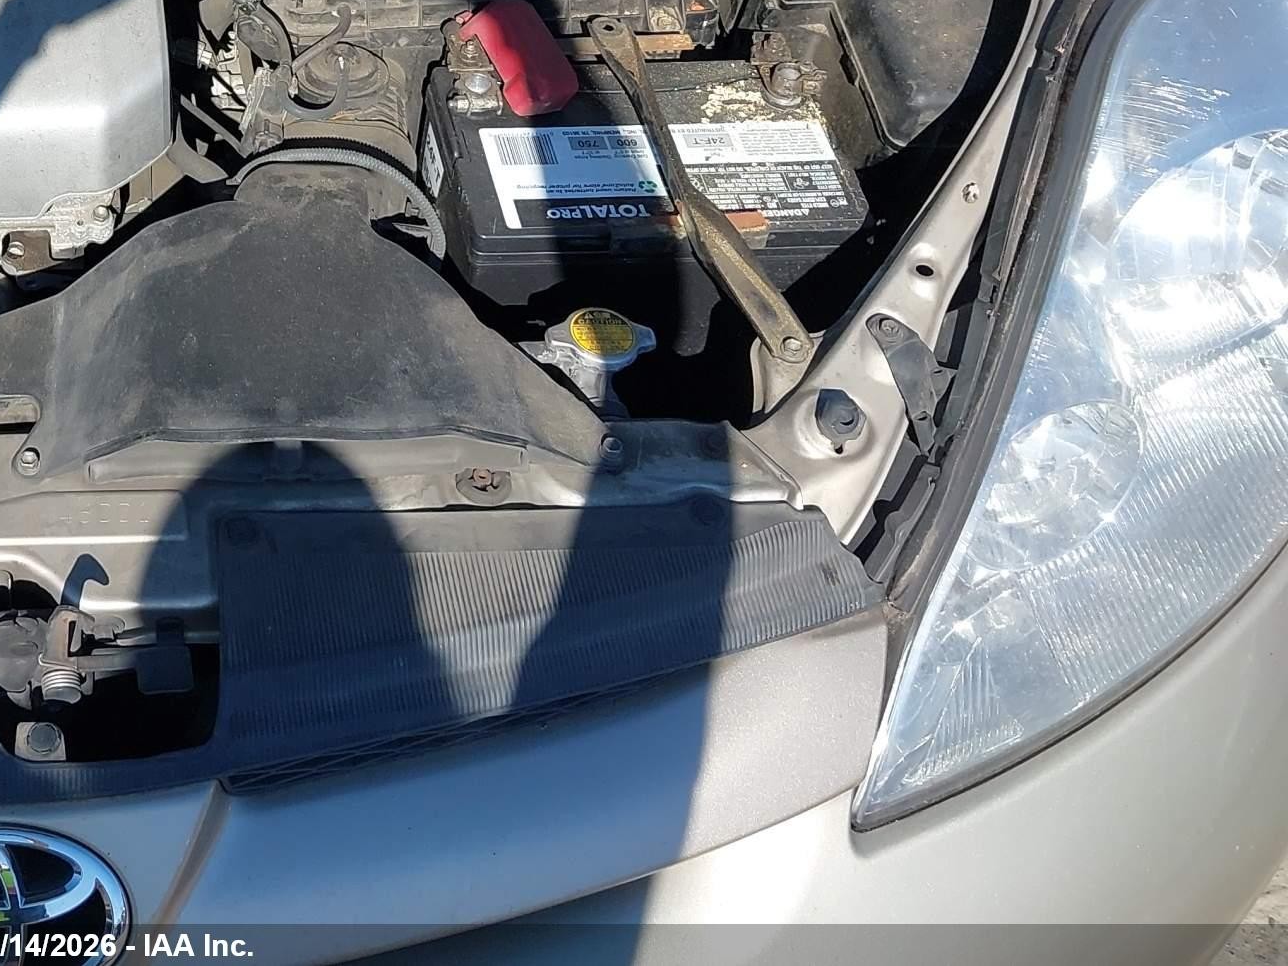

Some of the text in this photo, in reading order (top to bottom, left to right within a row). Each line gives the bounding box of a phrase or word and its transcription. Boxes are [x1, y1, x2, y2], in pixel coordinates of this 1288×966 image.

[577, 139, 599, 148] 750
[617, 138, 637, 147] 600
[692, 137, 725, 145] 24F-T
[546, 203, 651, 219] TOTALPRO
